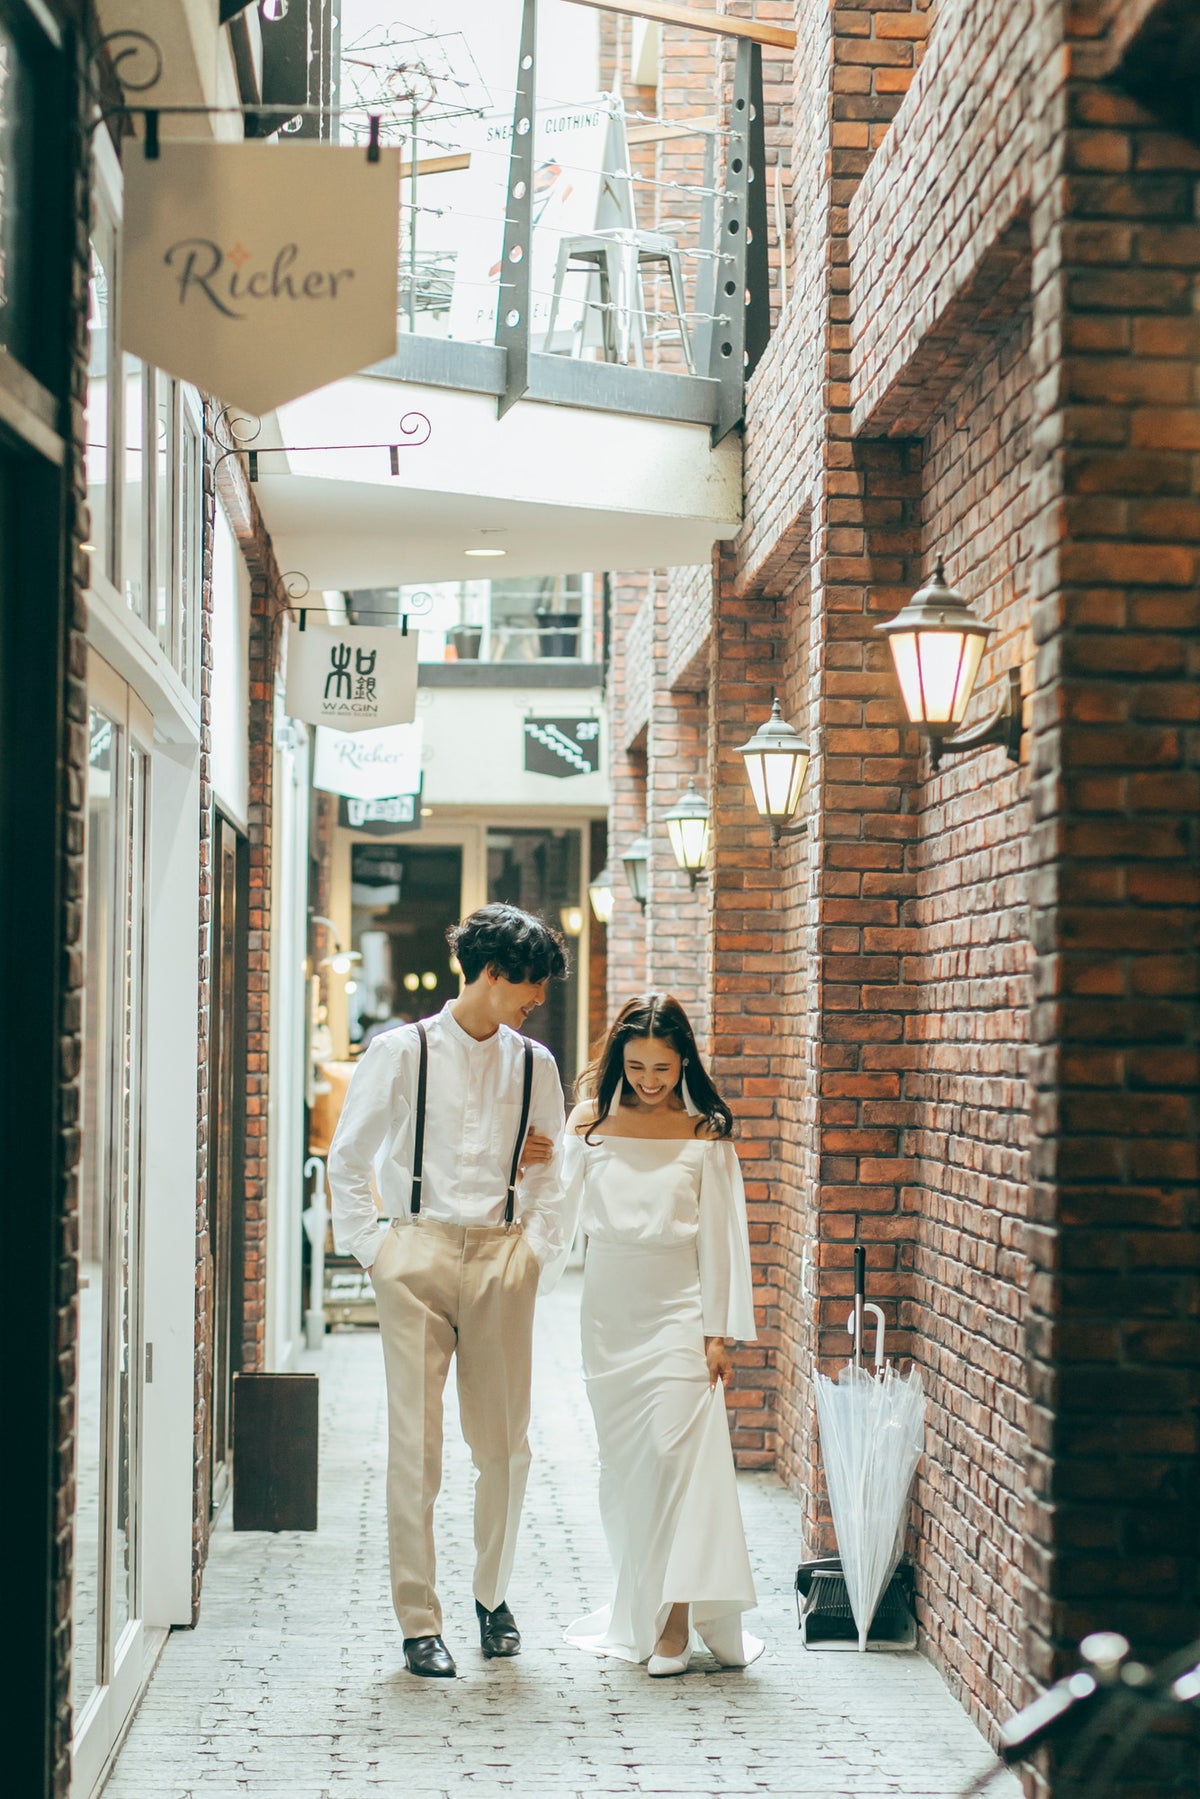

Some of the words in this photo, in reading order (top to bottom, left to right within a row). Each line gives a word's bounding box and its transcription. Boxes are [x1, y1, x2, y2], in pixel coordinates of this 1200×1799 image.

[545, 112, 599, 133] CLOTHING
[163, 238, 355, 320] Richer
[322, 702, 378, 713] WAGIN
[333, 739, 404, 770] Richer
